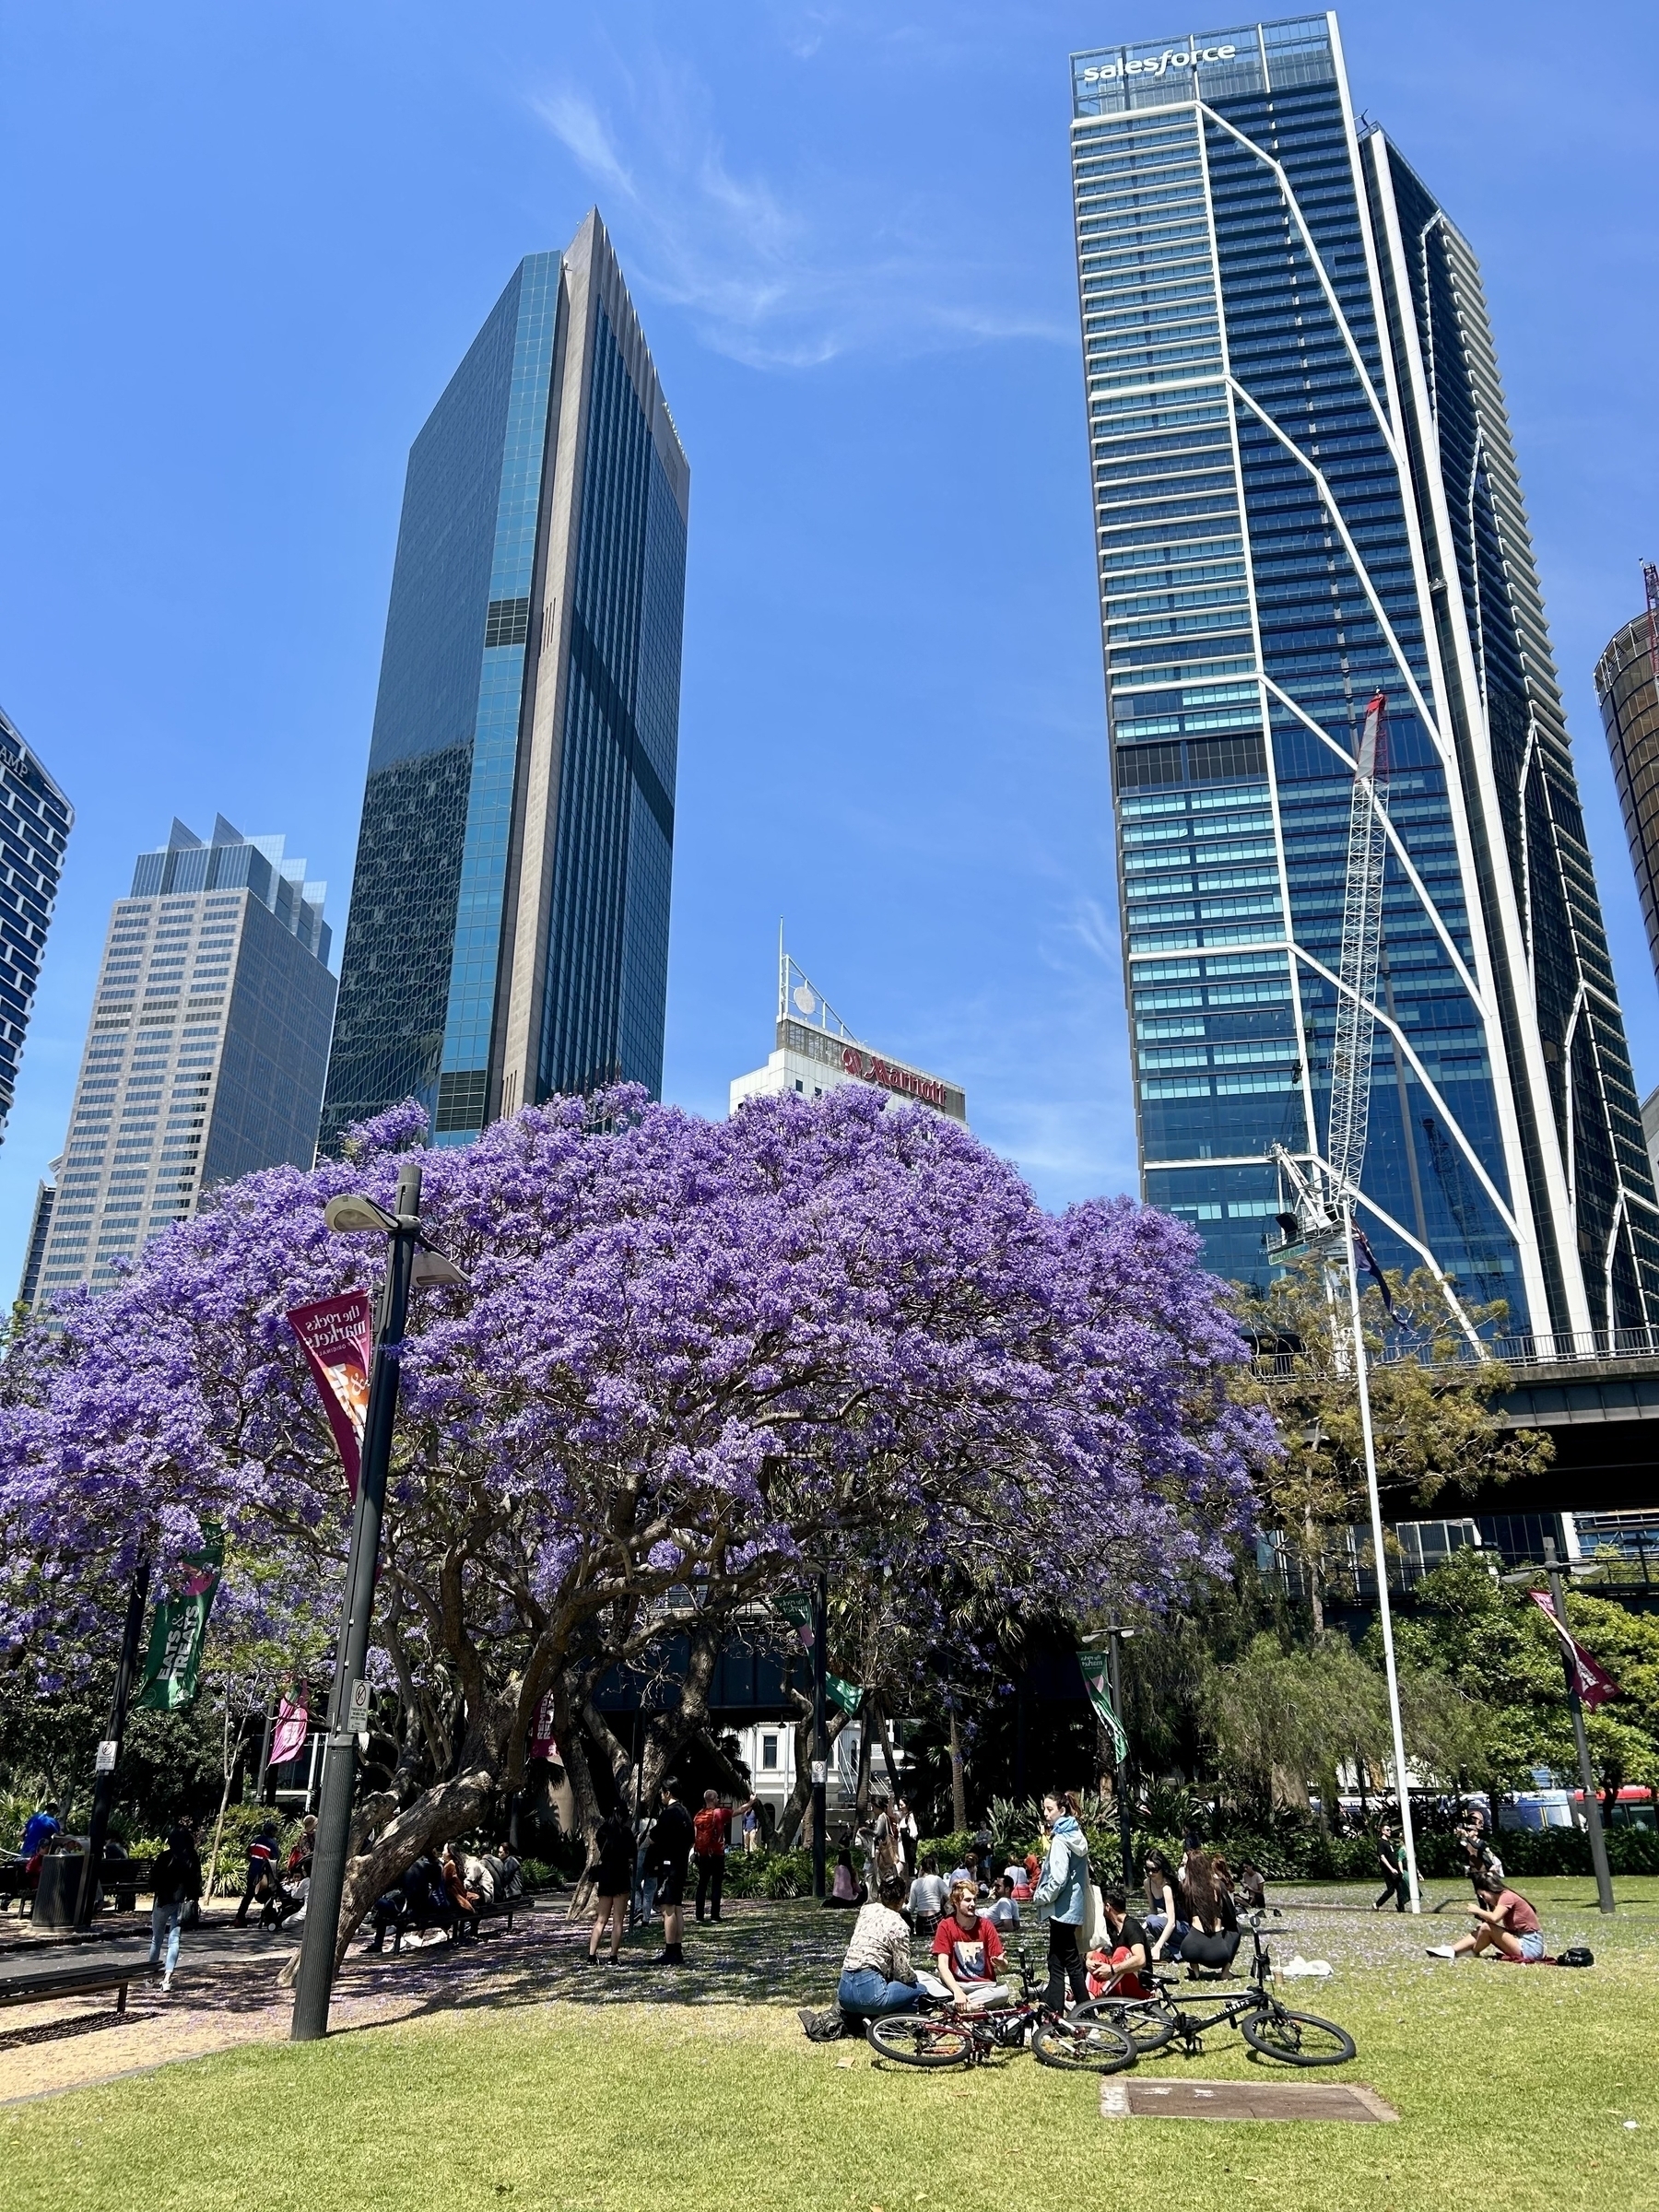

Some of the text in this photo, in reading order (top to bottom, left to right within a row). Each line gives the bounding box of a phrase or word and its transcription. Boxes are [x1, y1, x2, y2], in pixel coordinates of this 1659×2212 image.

[1084, 44, 1236, 81] salesforce
[0, 746, 29, 778] AMP
[863, 1056, 947, 1106] Marriott
[157, 1630, 180, 1681] EATS
[172, 1605, 200, 1678] TREATS
